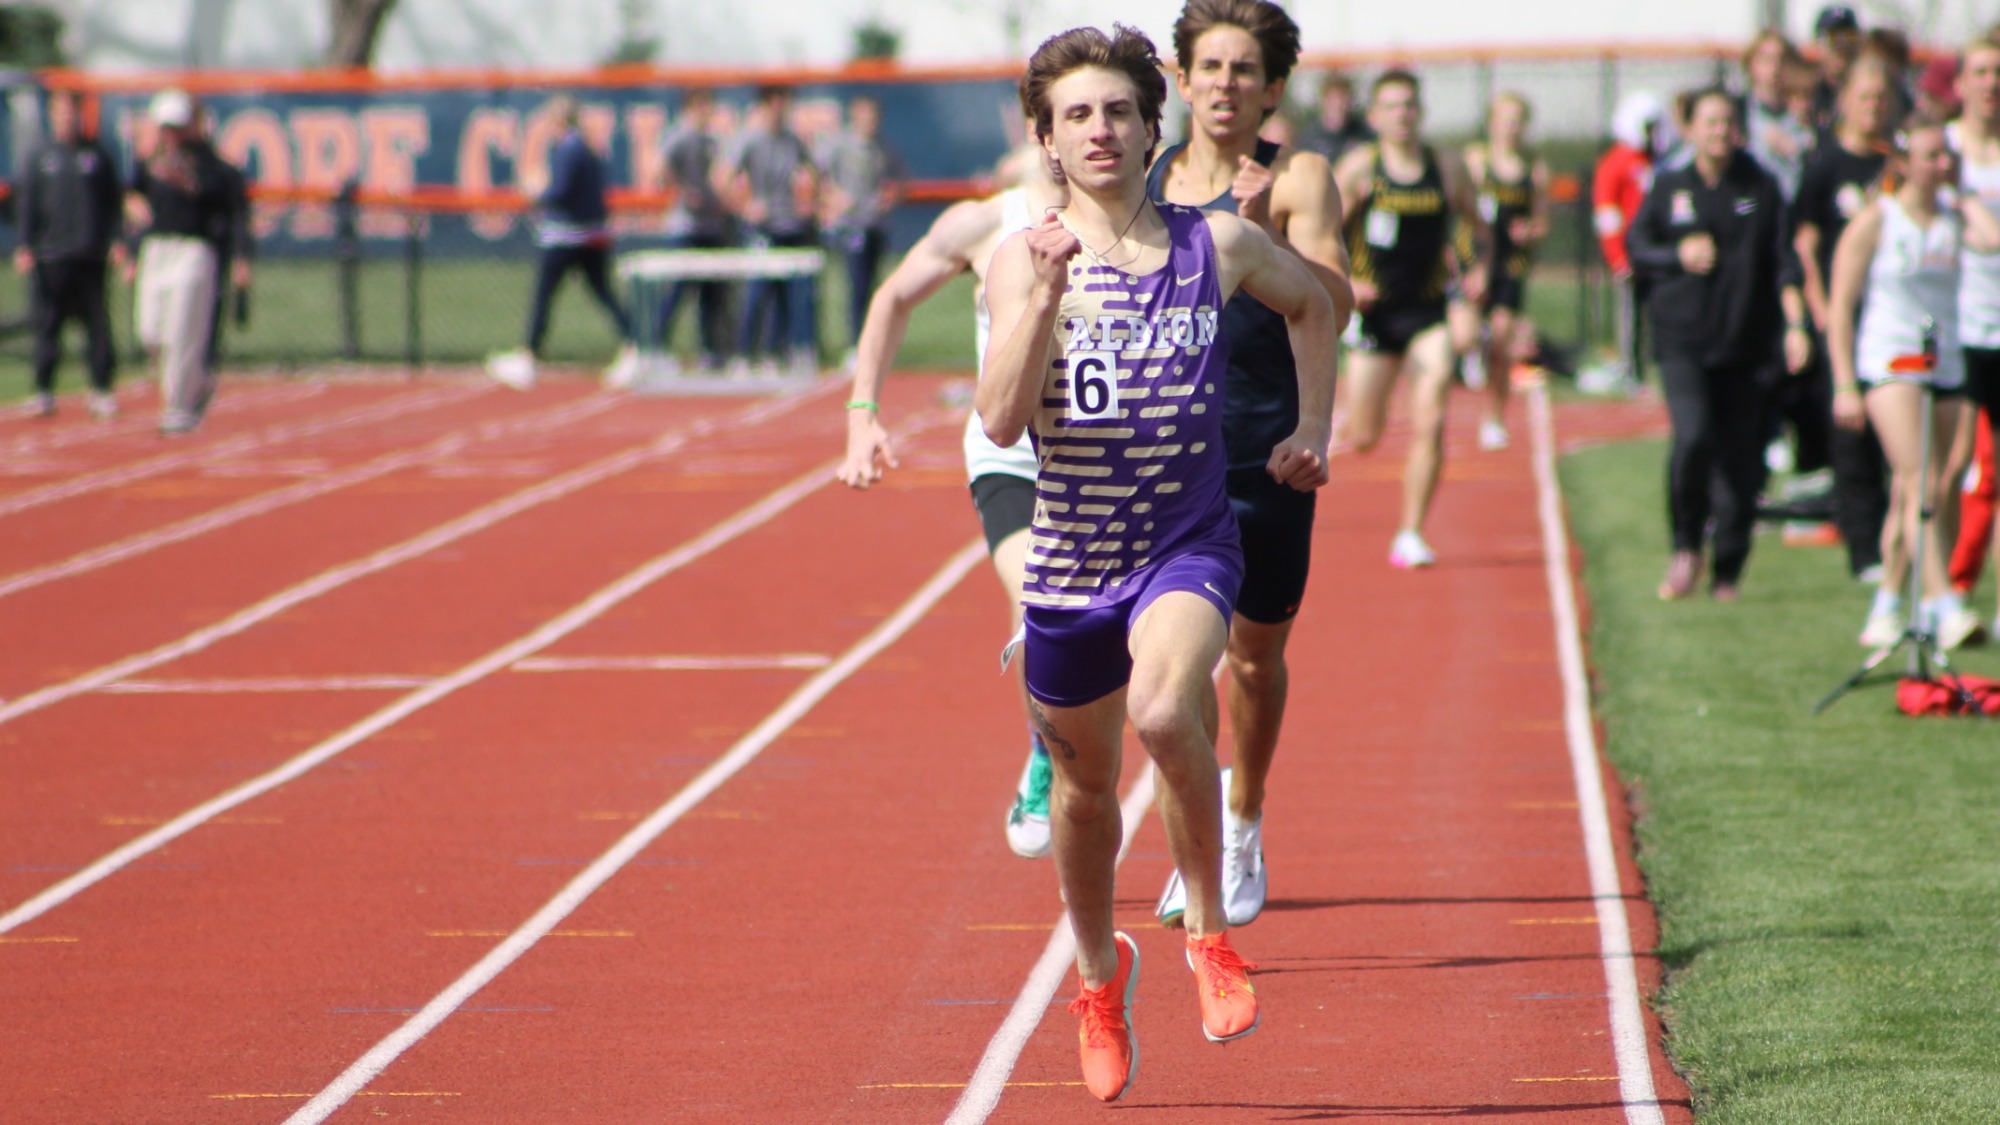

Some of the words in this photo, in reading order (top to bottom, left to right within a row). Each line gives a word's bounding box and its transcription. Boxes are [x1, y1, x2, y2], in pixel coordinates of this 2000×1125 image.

[130, 104, 430, 240] OPE
[1067, 311, 1218, 351] ALBION
[1074, 358, 1109, 415] 6
